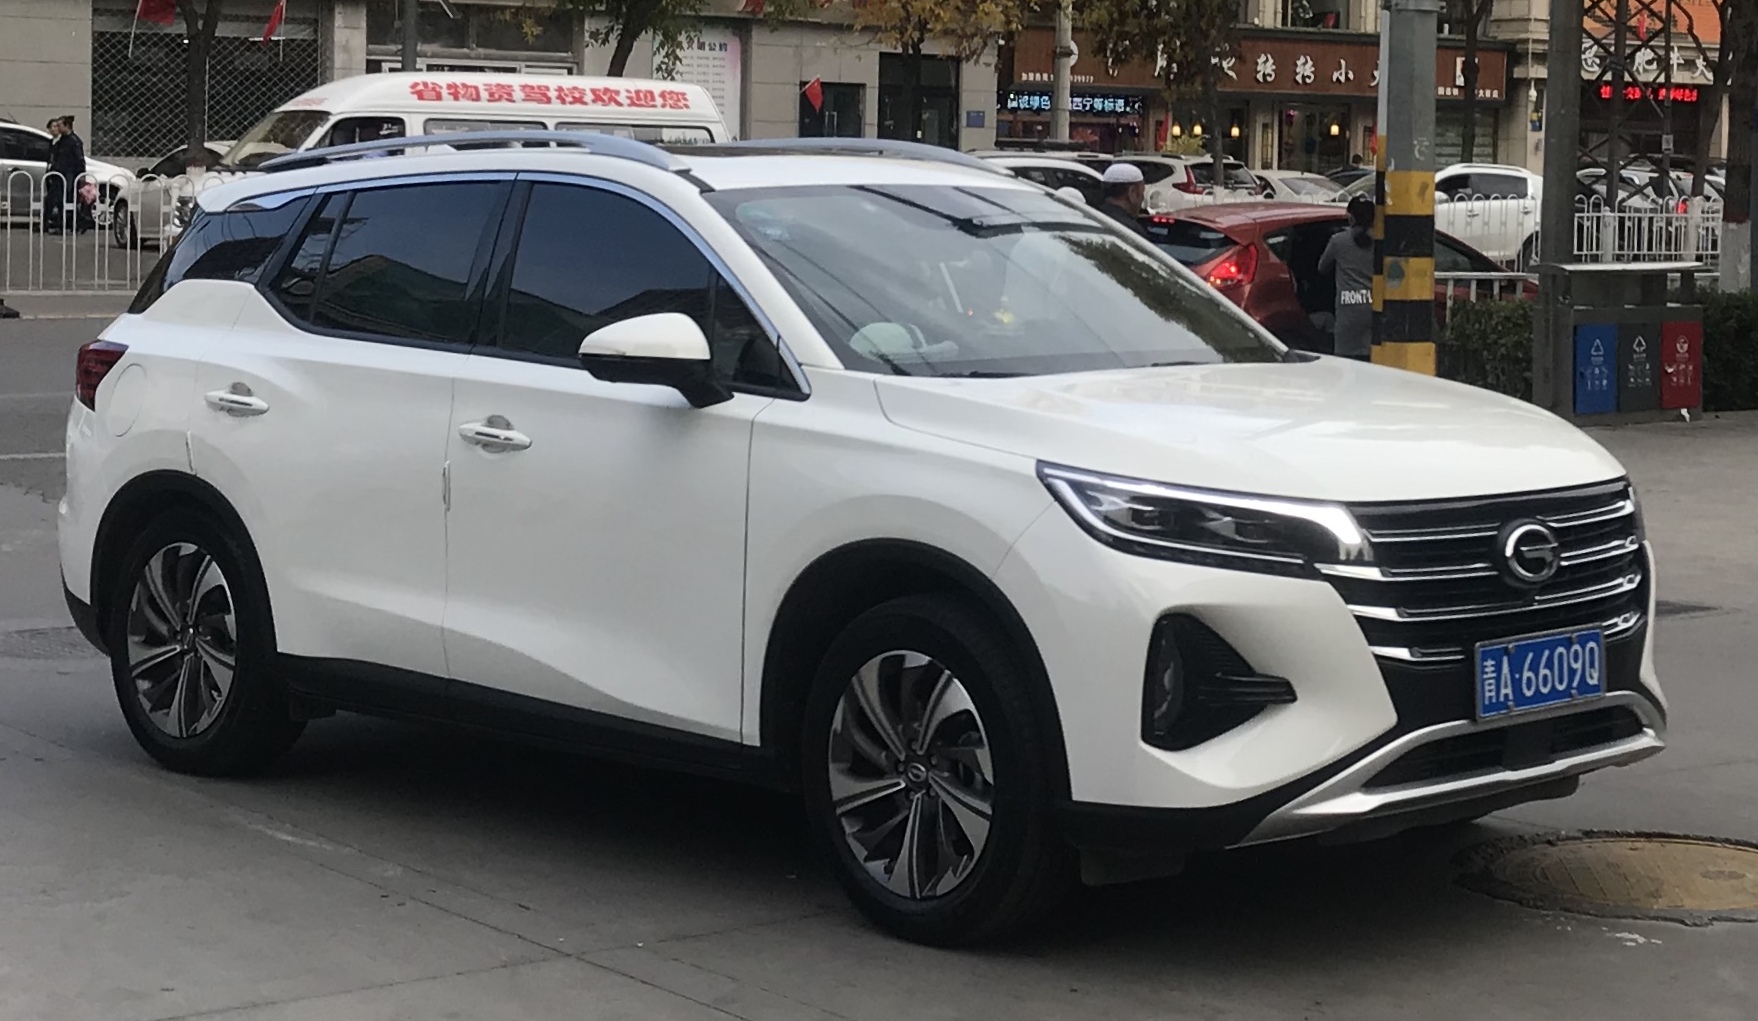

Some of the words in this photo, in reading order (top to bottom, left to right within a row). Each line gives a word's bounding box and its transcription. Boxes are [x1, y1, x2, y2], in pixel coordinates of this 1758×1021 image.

[408, 81, 691, 111] 省物资驾校欢迎您
